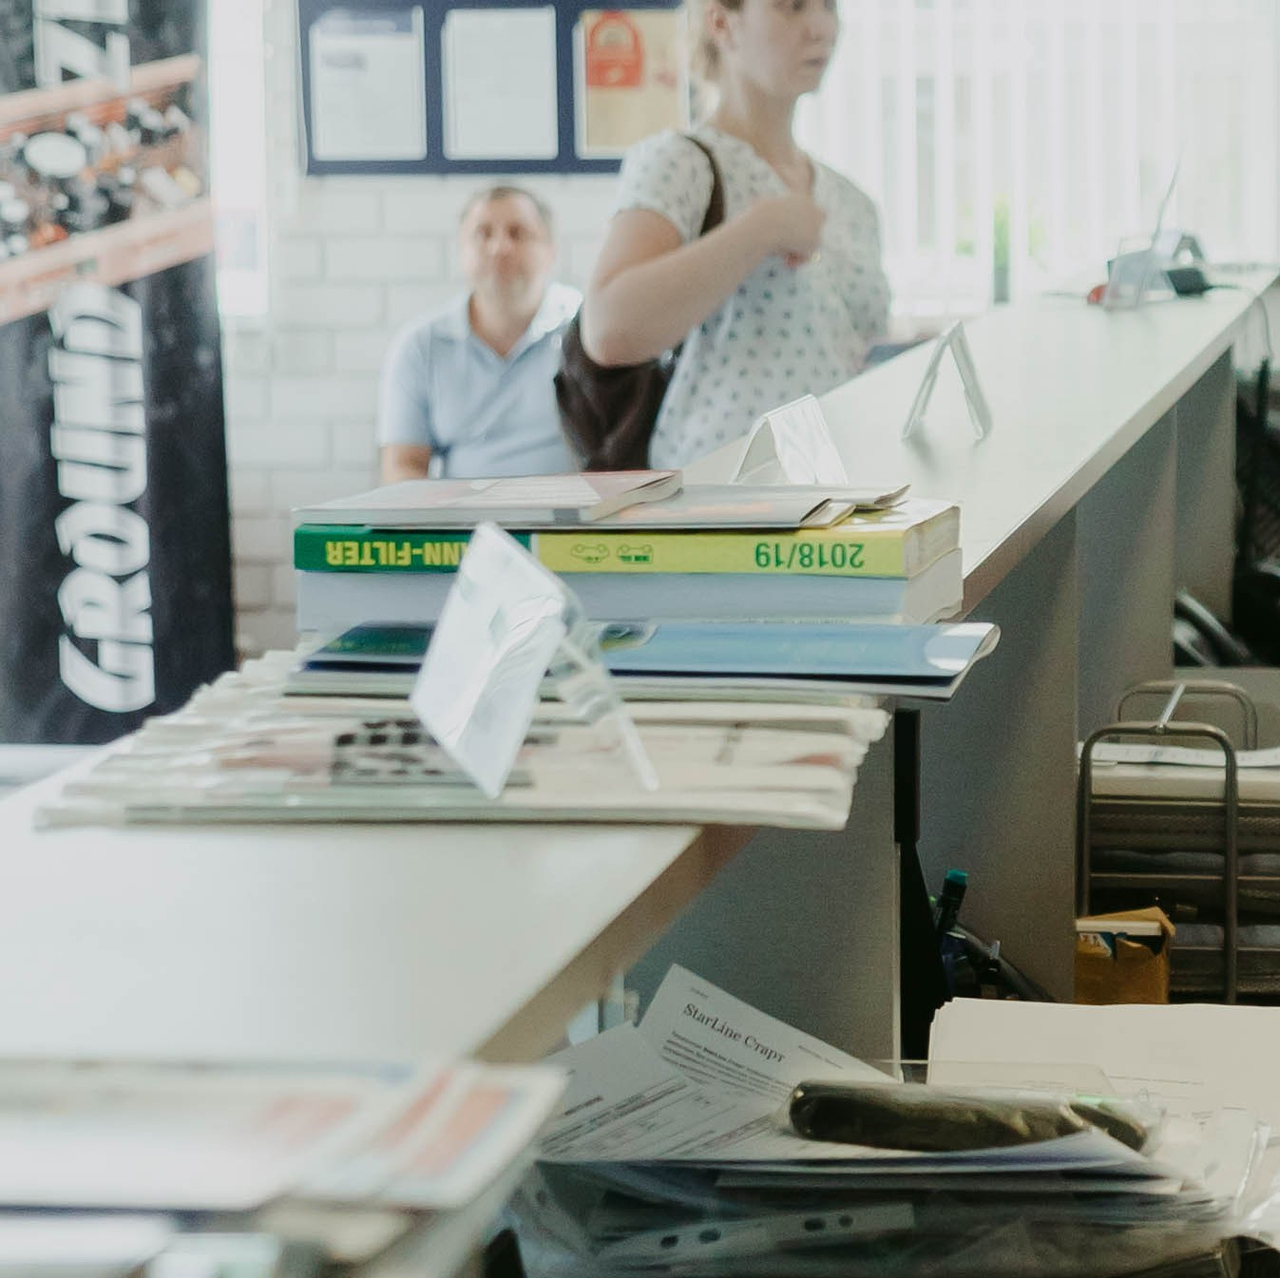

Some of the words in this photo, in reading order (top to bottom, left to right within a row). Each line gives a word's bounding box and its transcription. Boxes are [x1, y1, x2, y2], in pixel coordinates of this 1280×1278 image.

[47, 280, 156, 713] GROUND
[325, 541, 467, 566] NN-FILTER
[755, 542, 865, 569] 2018/19
[683, 1002, 742, 1041] StarLine
[744, 1034, 786, 1063] Старт
